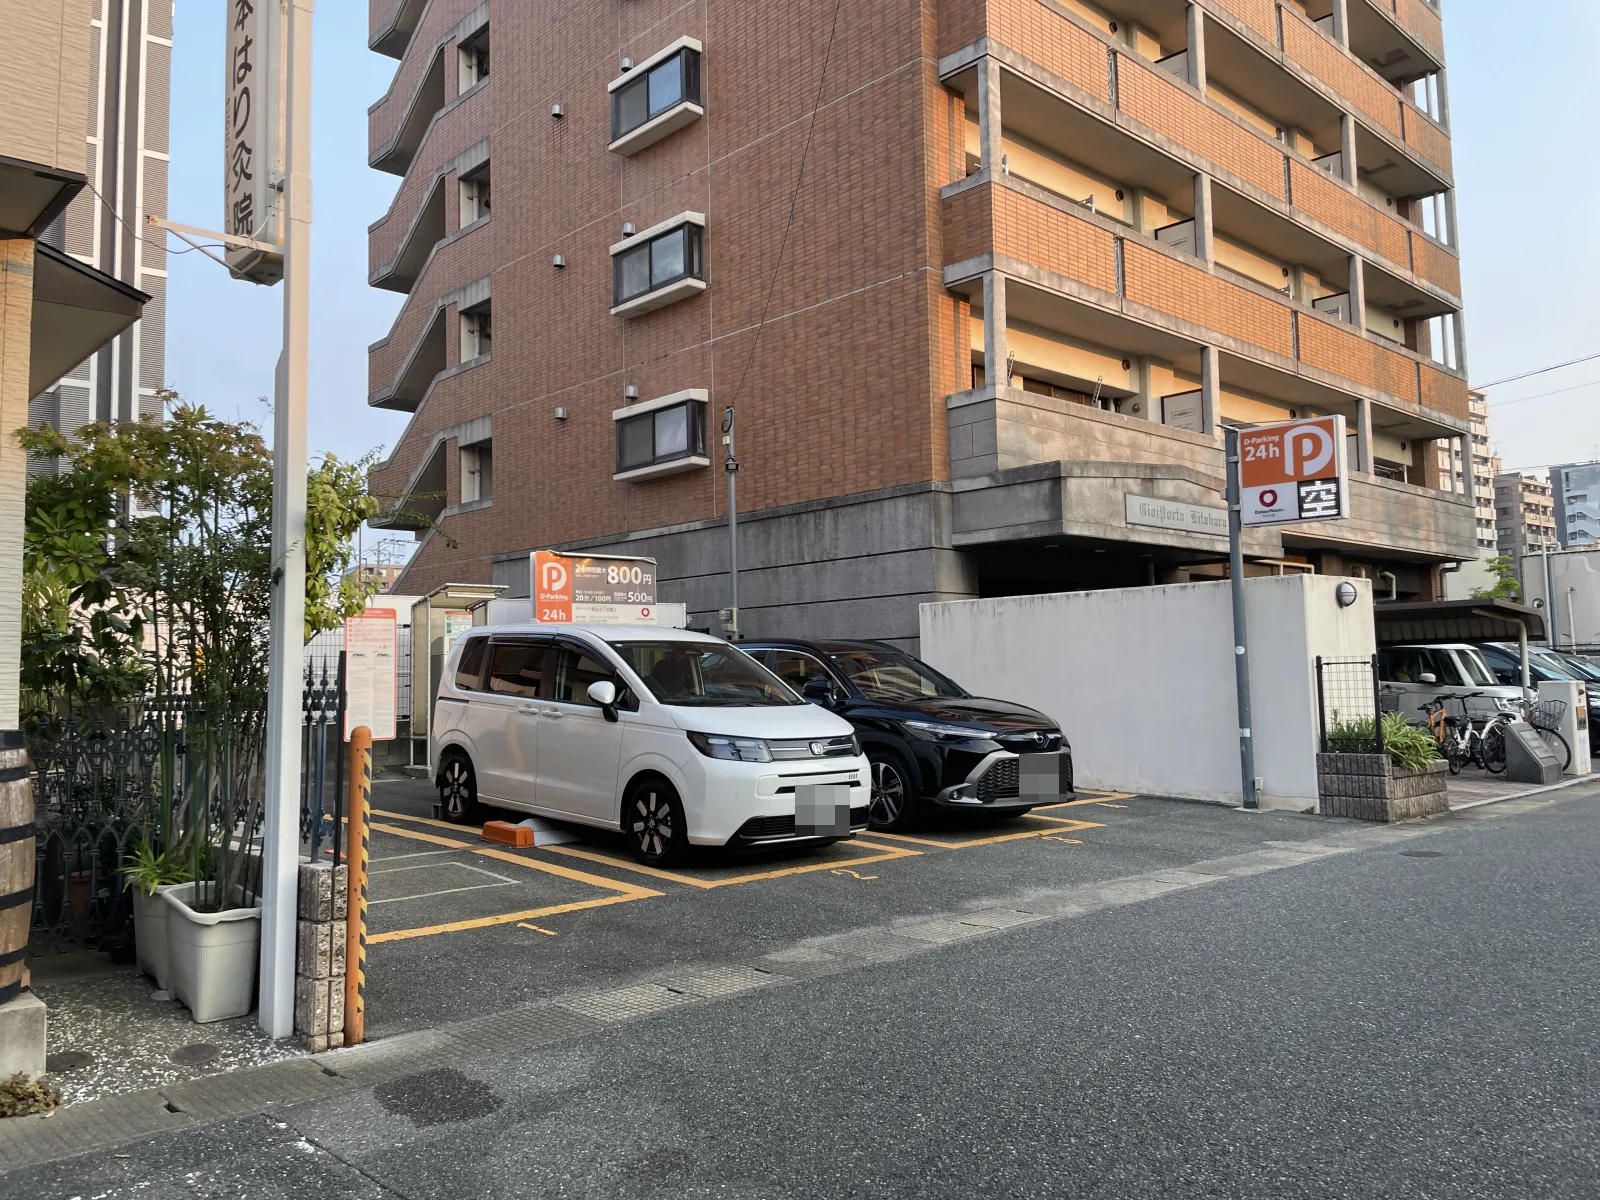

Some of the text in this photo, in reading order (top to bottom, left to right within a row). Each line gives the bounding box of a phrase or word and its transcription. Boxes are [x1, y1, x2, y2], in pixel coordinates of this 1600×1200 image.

[1243, 435, 1280, 446] D-Parking
[1244, 443, 1280, 462] 24h
[1299, 480, 1339, 518] 空
[607, 565, 652, 585] 800円
[540, 593, 569, 602] D-Parking
[627, 592, 653, 603] 500円
[542, 608, 566, 620] 24h
